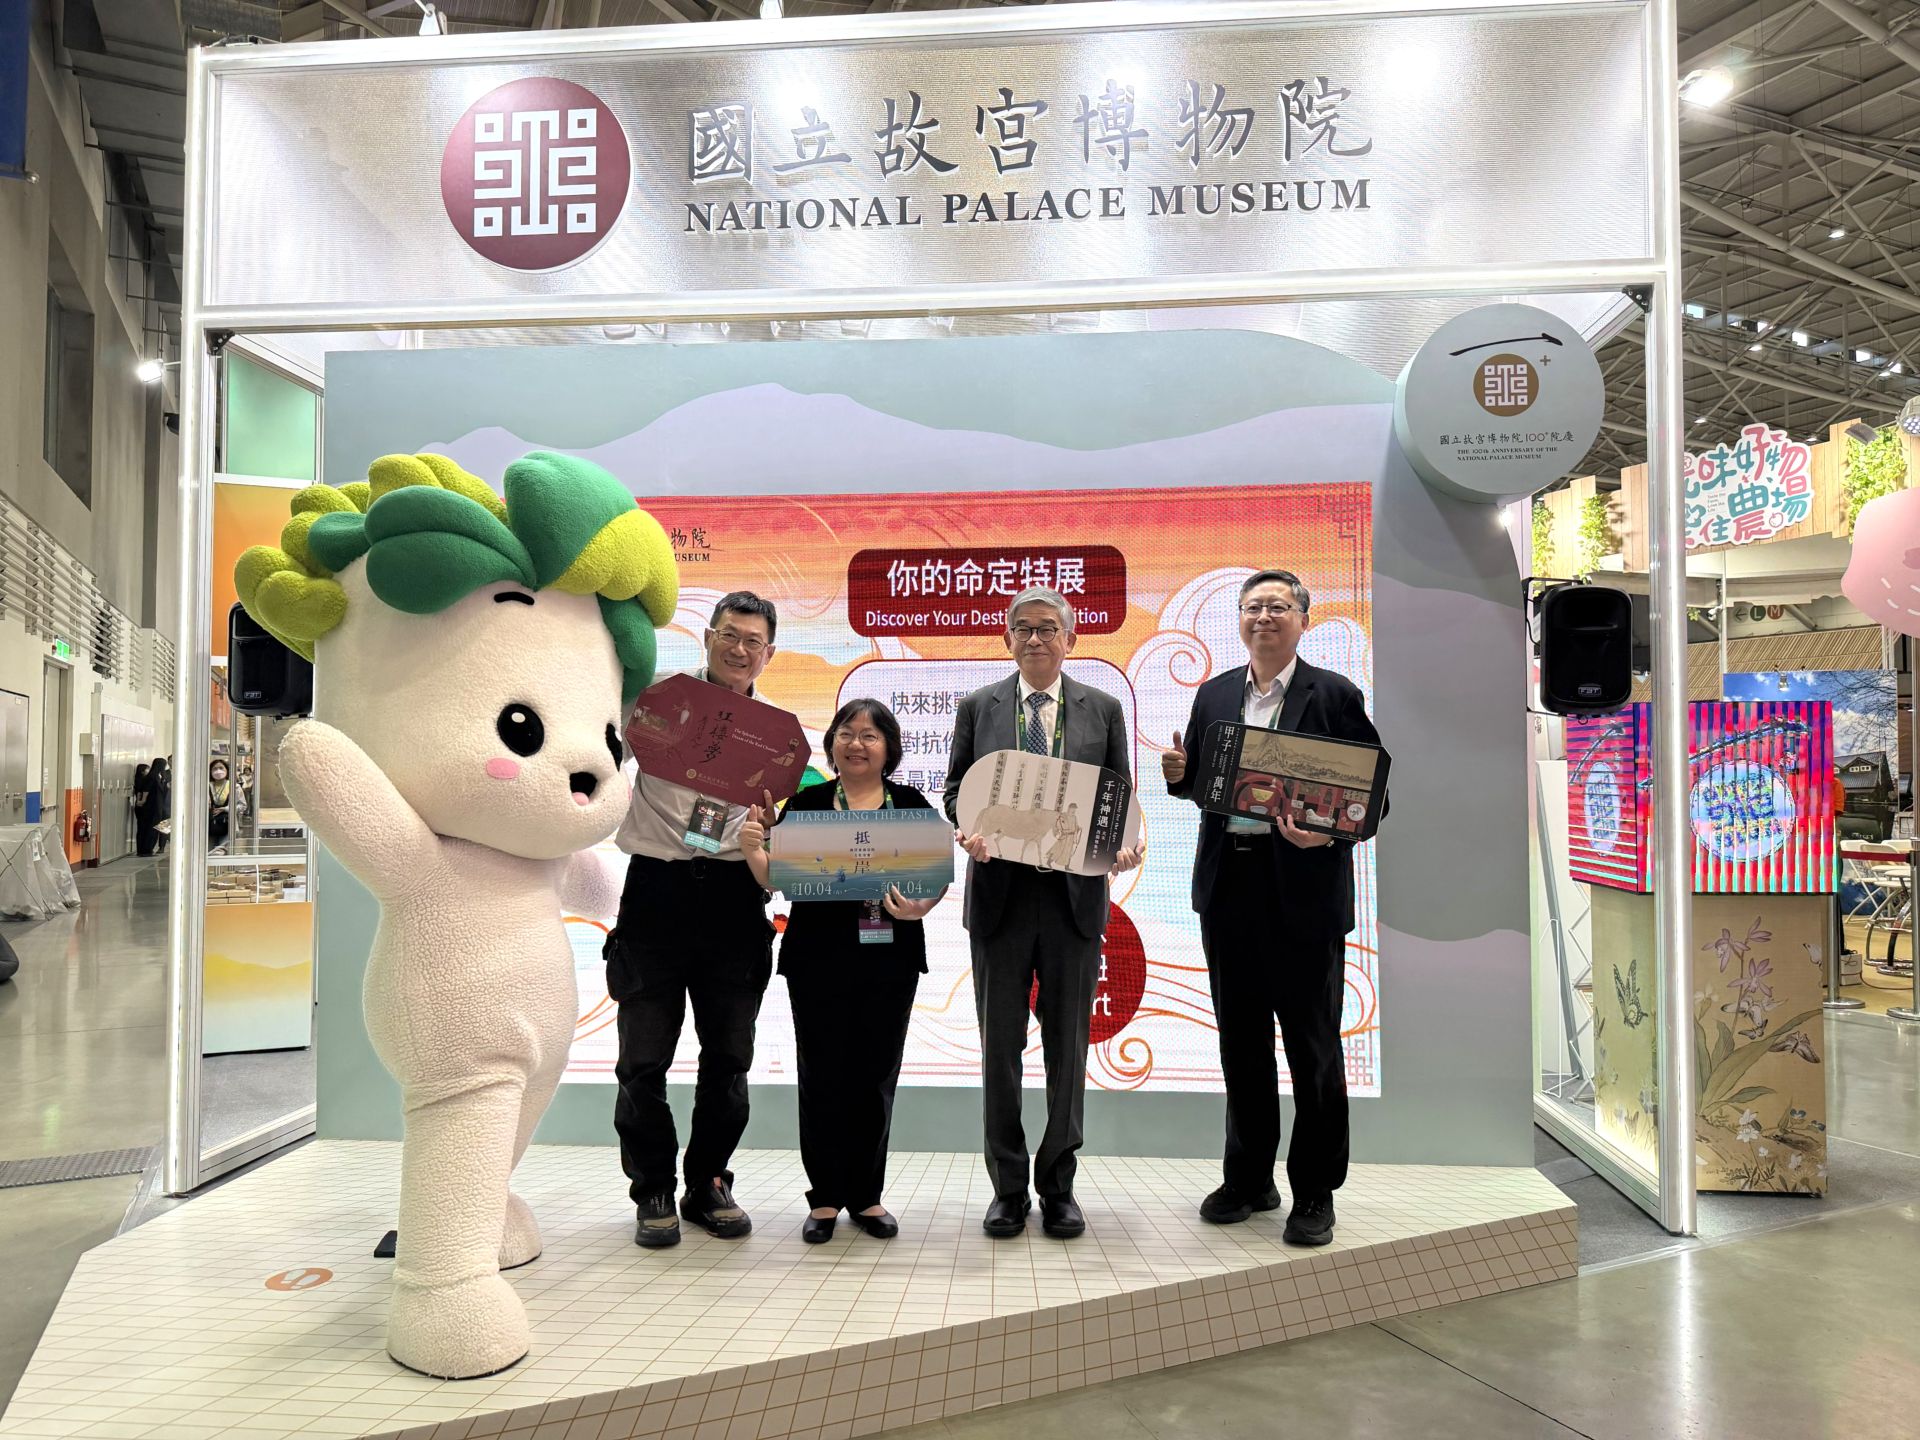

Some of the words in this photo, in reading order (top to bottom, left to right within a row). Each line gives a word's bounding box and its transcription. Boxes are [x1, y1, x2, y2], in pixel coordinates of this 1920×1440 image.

[688, 76, 1374, 185] 國立故宮博物院
[684, 193, 922, 236] NATIONAL
[942, 185, 1126, 227] PALACE
[1148, 177, 1372, 217] MUSEUM
[670, 527, 711, 550] 物院
[674, 553, 710, 562] USEUM
[886, 557, 1086, 598] 你的命定特展
[865, 610, 929, 627] Discover
[932, 610, 967, 627] Your
[971, 609, 1008, 626] Desti
[1073, 607, 1109, 624] ition
[1221, 726, 1235, 752] 甲子
[1096, 780, 1116, 828] 千年神遇
[796, 811, 869, 822] HARBORING
[873, 810, 896, 821] THE
[901, 810, 930, 820] PAST
[854, 831, 871, 845] 抵
[854, 860, 870, 874] 岸
[797, 881, 832, 896] 10.04
